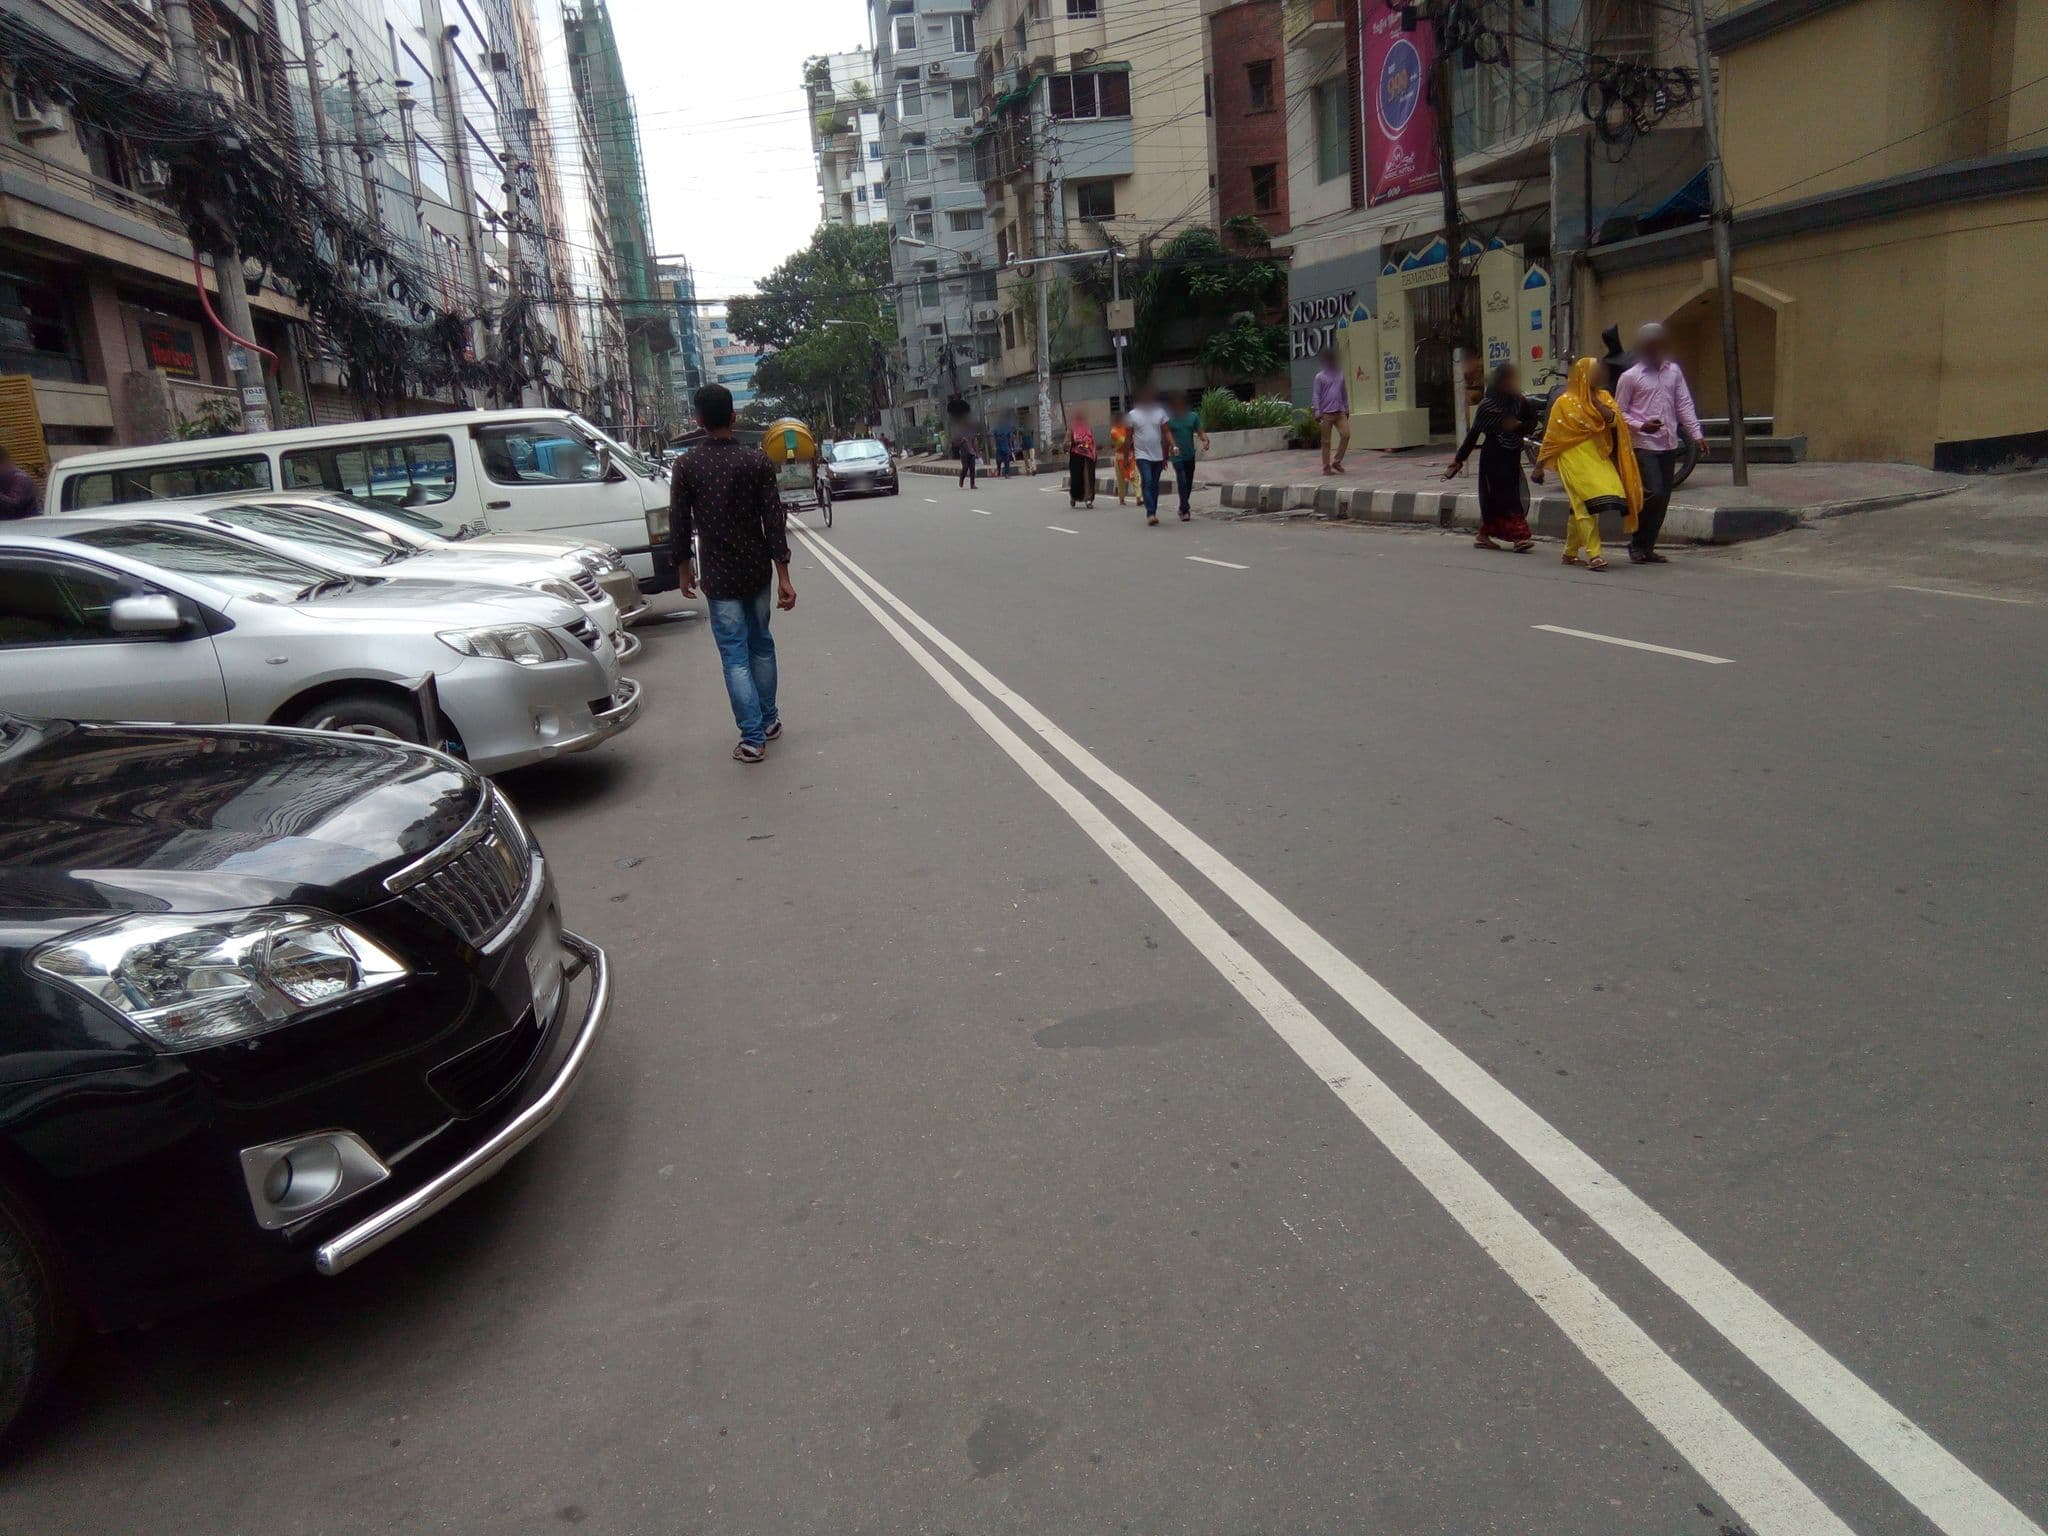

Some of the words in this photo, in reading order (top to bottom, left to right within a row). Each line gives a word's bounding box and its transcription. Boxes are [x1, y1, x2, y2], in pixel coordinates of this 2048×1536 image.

[1290, 290, 1356, 325] NORDIC
[1488, 341, 1510, 359] 25%
[1384, 356, 1401, 372] 25%
